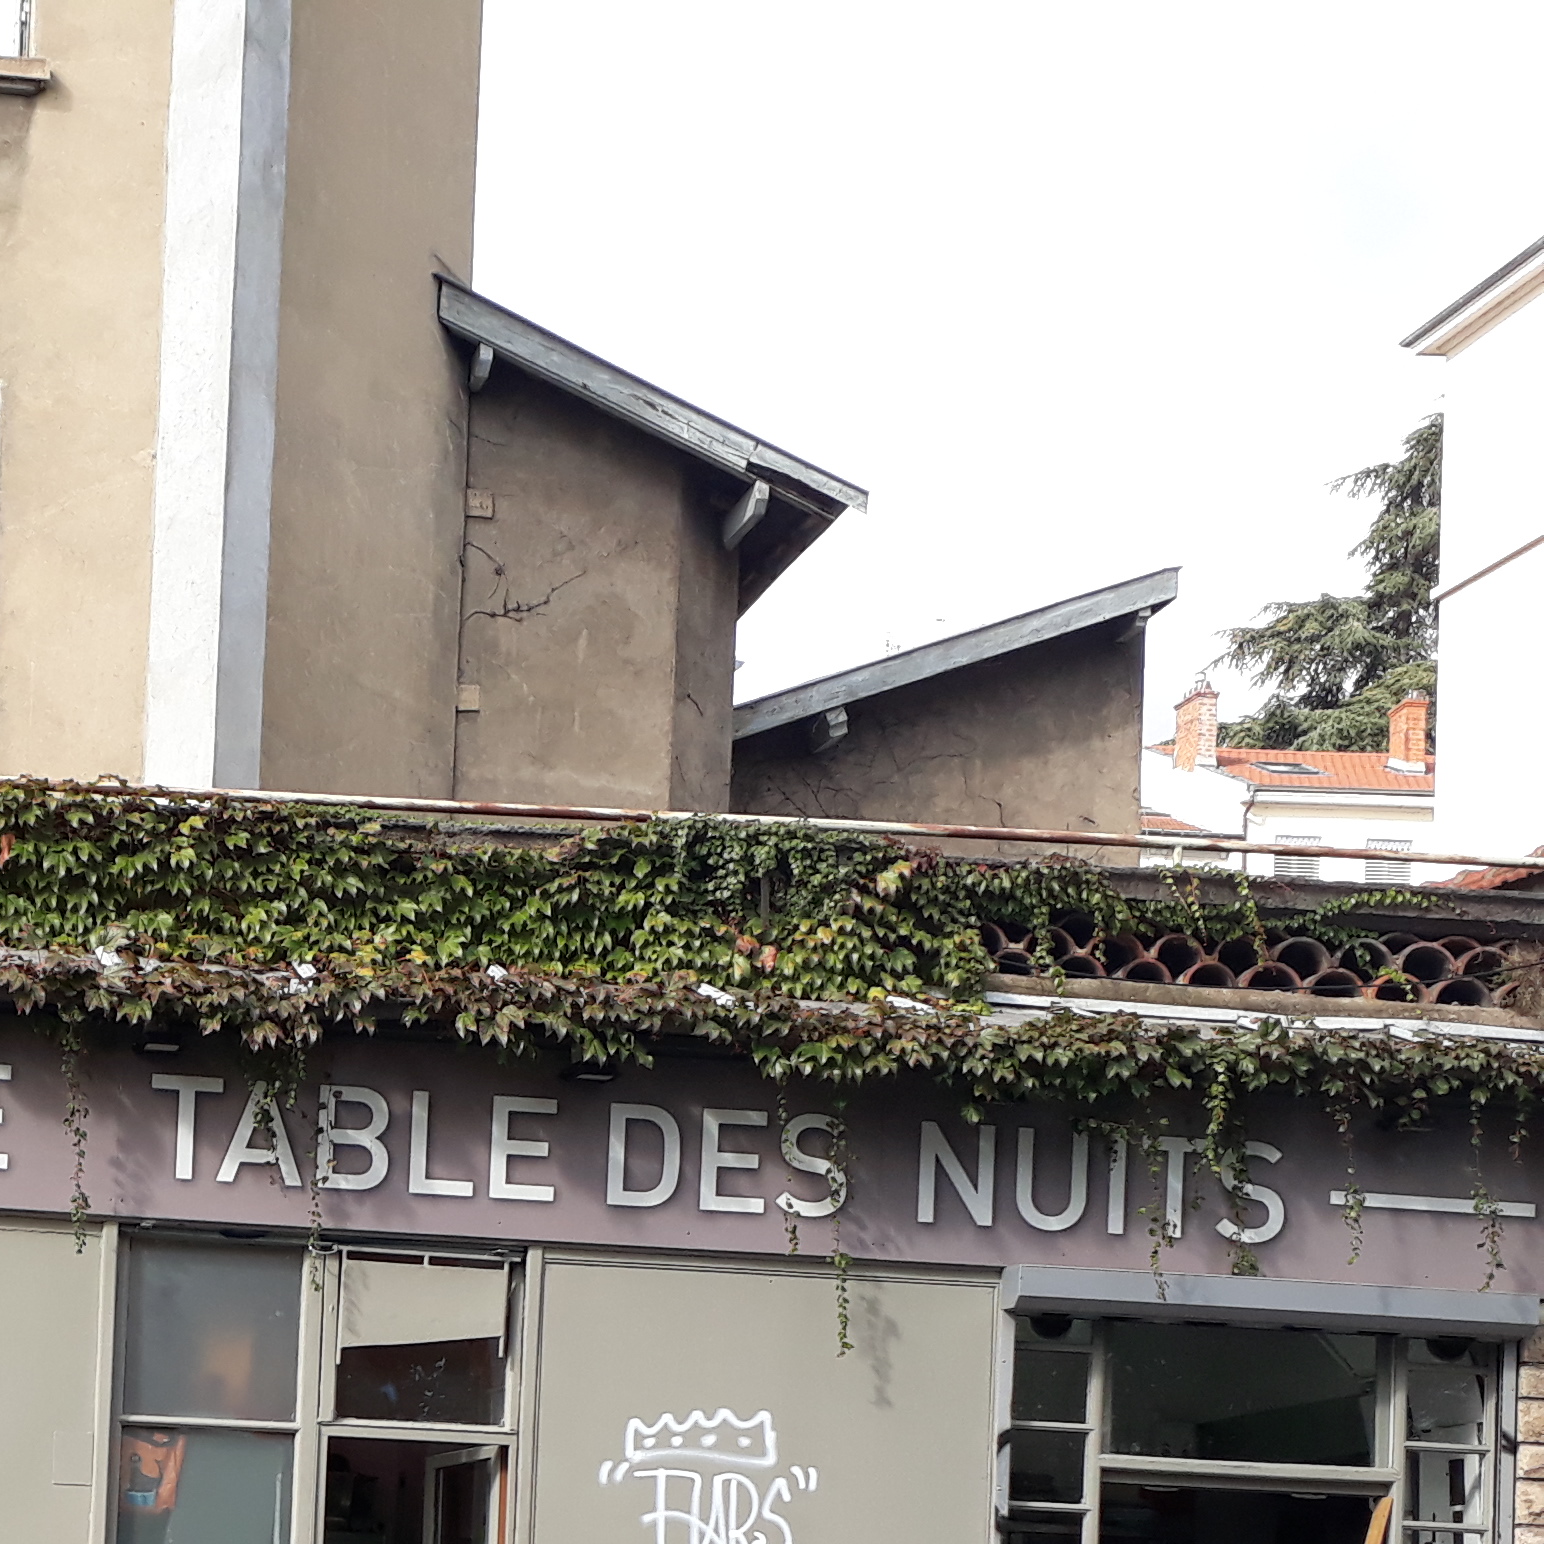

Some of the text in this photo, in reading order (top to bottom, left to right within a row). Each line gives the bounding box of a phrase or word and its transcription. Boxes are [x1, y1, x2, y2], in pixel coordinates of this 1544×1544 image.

[151, 1072, 559, 1203] TABLE
[605, 1101, 848, 1219] DES
[916, 1119, 1287, 1245] NUITS
